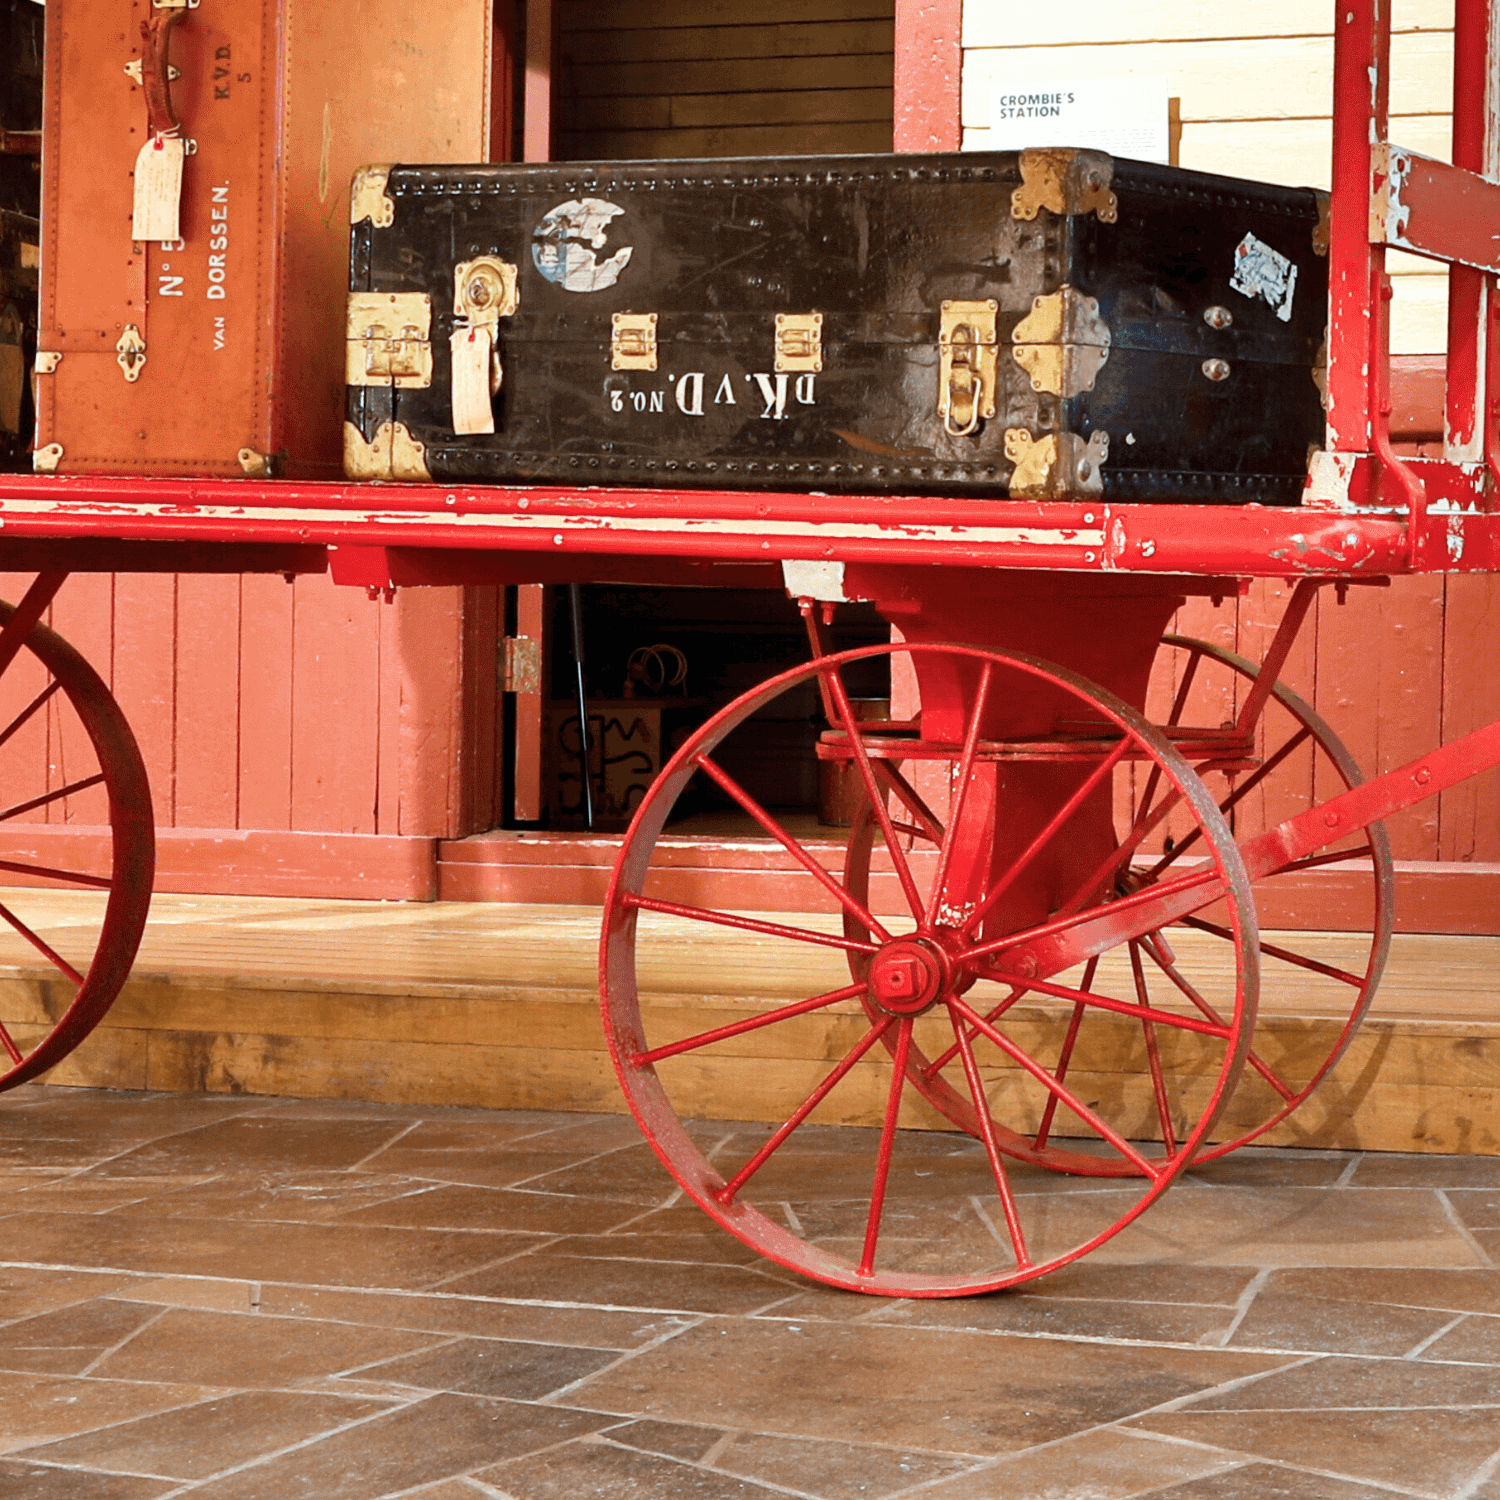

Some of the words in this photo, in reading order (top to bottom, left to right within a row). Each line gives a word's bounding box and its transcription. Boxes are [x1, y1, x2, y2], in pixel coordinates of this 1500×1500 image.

[1000, 92, 1075, 107] CROMBIE'S
[1000, 106, 1060, 119] STATION
[206, 180, 230, 300] DORSSEN.
[213, 316, 225, 350] VAN
